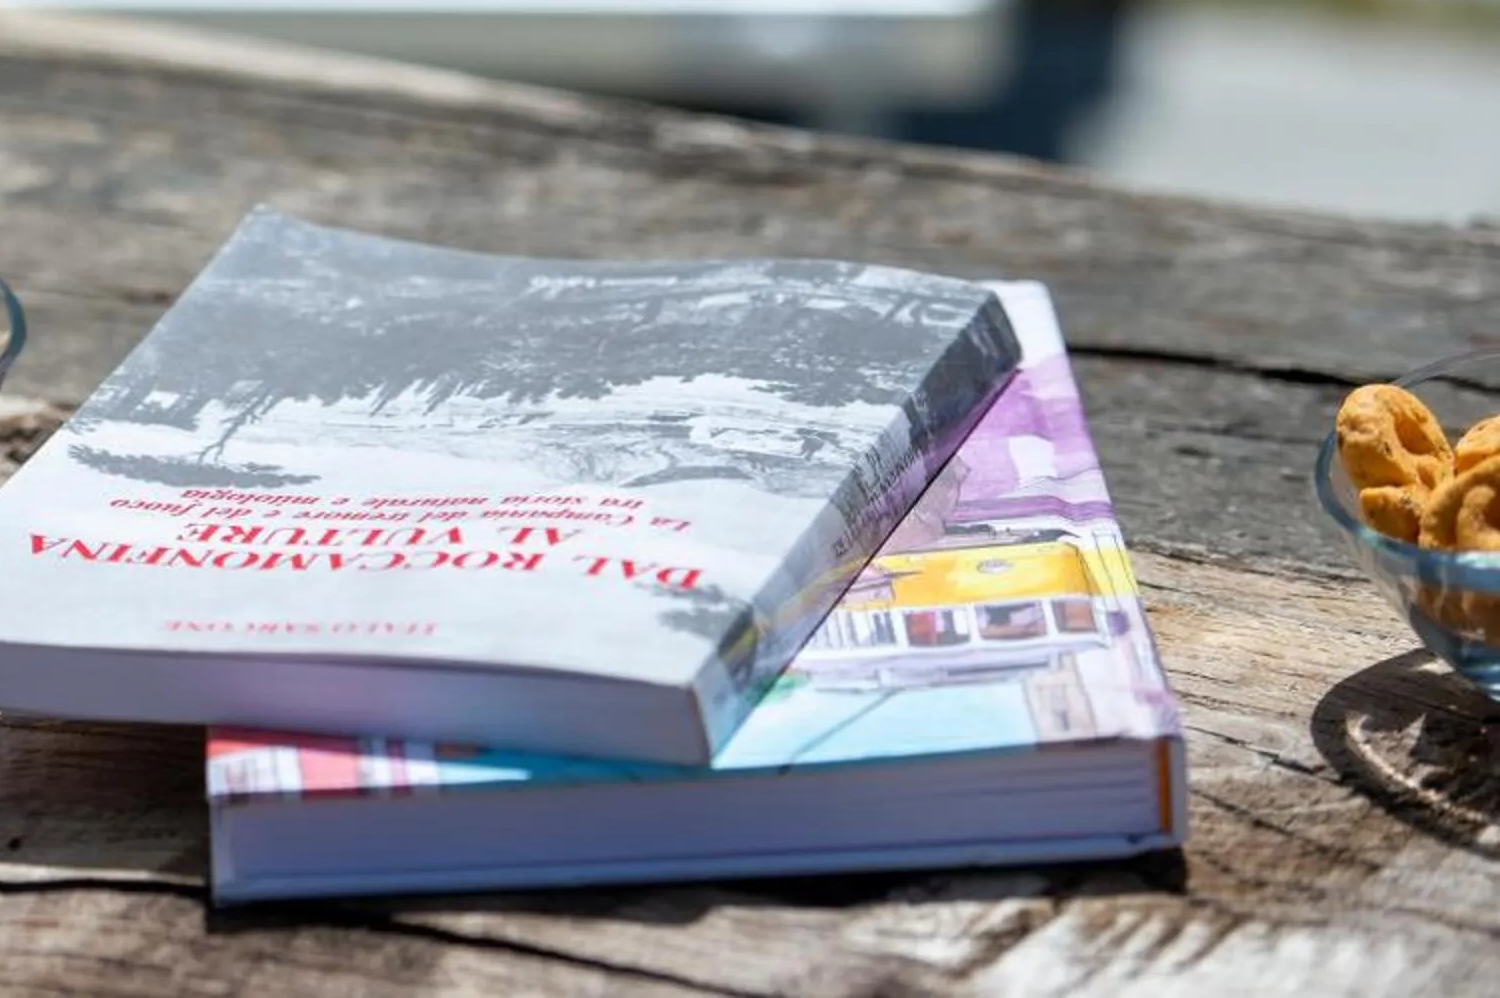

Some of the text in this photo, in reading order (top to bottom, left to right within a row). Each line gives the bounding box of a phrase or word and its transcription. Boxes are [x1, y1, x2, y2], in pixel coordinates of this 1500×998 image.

[179, 488, 645, 509] tra storia naturale e mitologia
[108, 498, 692, 532] La Campania del tremore e del fuoco
[176, 522, 582, 547] AL VULTURE
[28, 532, 704, 591] DAL ROCCAMONFINA
